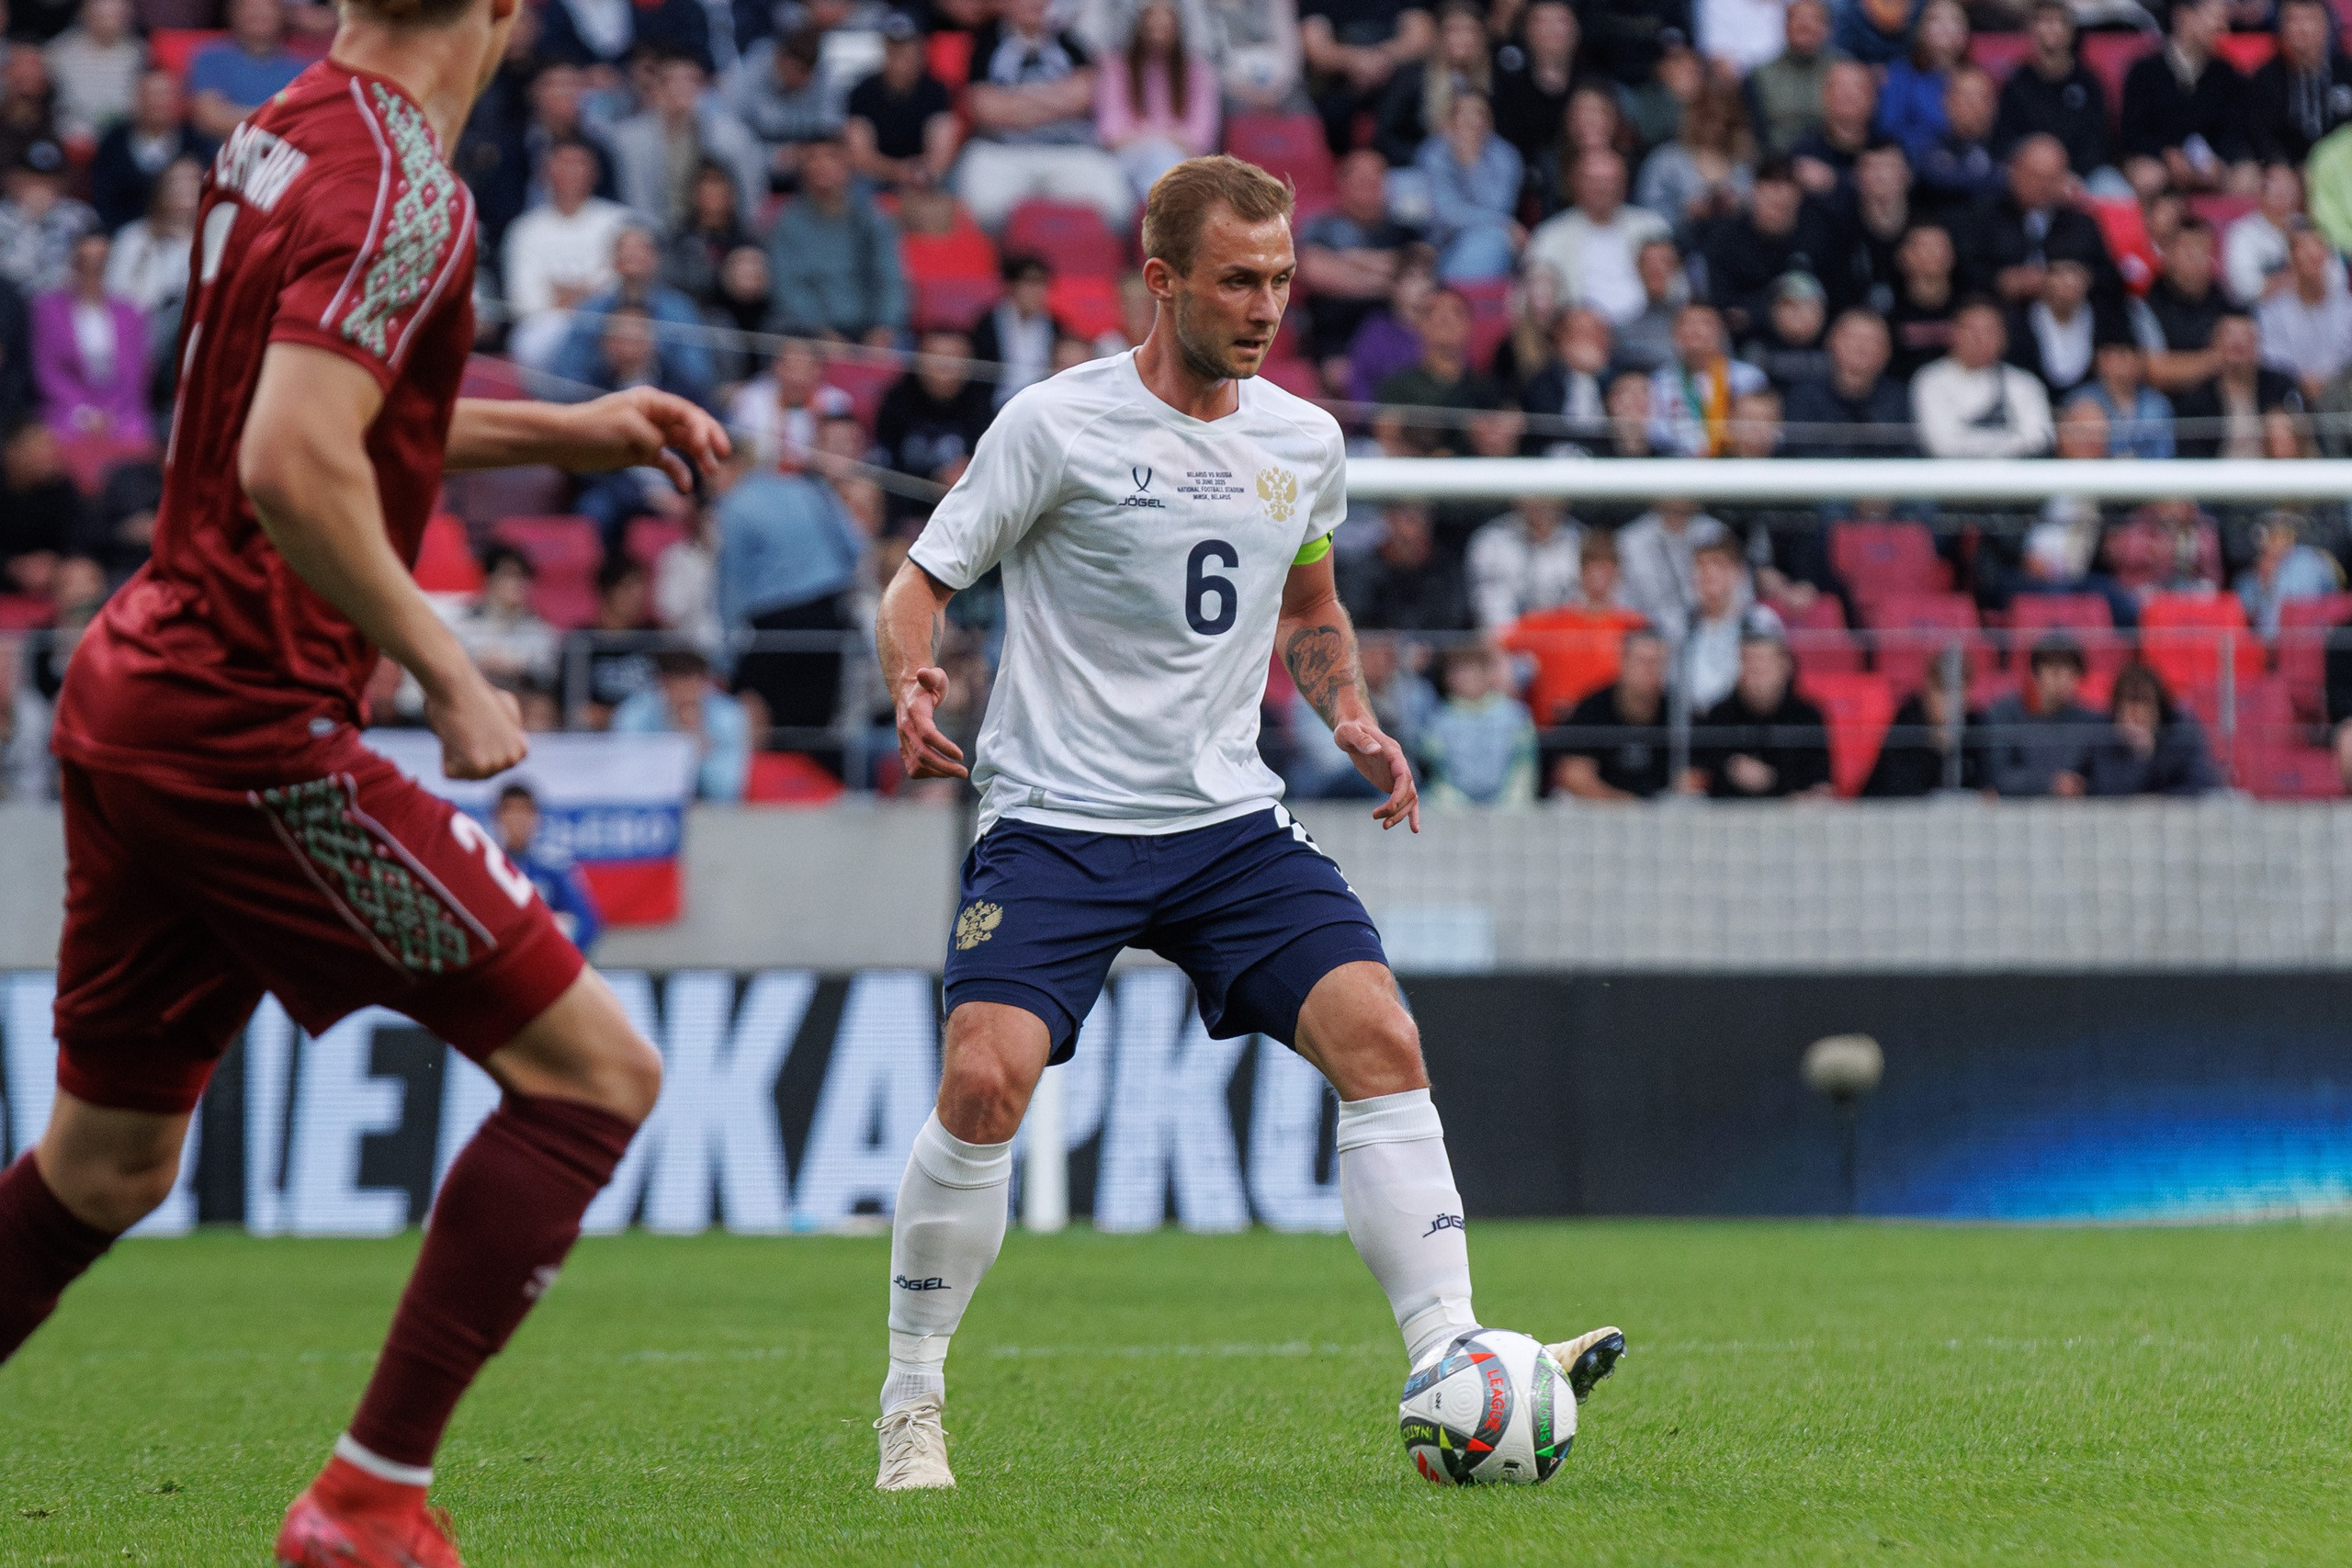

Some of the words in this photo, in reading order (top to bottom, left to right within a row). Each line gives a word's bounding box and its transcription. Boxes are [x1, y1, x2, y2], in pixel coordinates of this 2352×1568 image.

[1118, 494, 1166, 509] JÖGEL
[1185, 538, 1239, 636] 6
[1422, 1213, 1465, 1238] JÖG
[1485, 1368, 1506, 1433] LEAGUE
